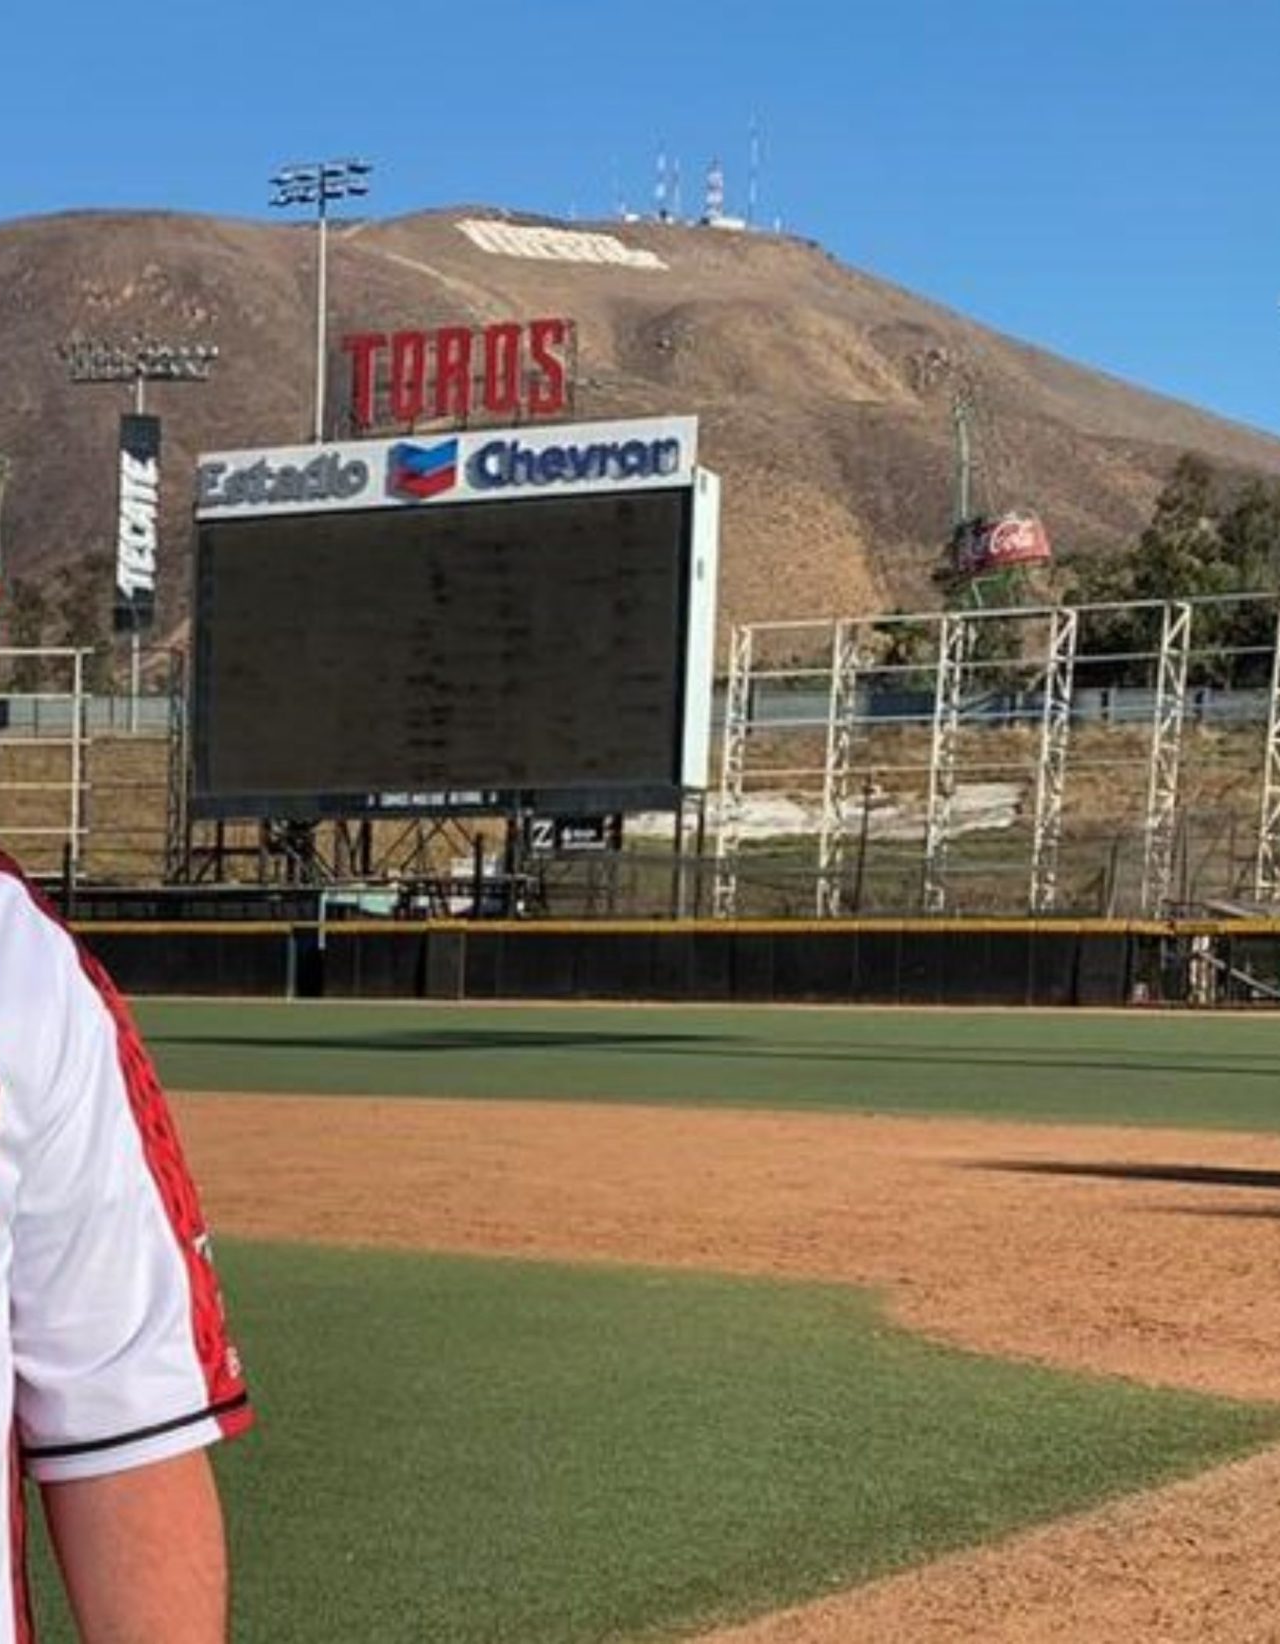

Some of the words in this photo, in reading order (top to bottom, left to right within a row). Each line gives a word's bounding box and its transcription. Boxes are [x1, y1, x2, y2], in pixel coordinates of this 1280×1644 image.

[341, 318, 570, 428] TOROS
[117, 450, 158, 598] TECATE
[200, 452, 369, 507] Estadio
[465, 437, 679, 489] Chevron
